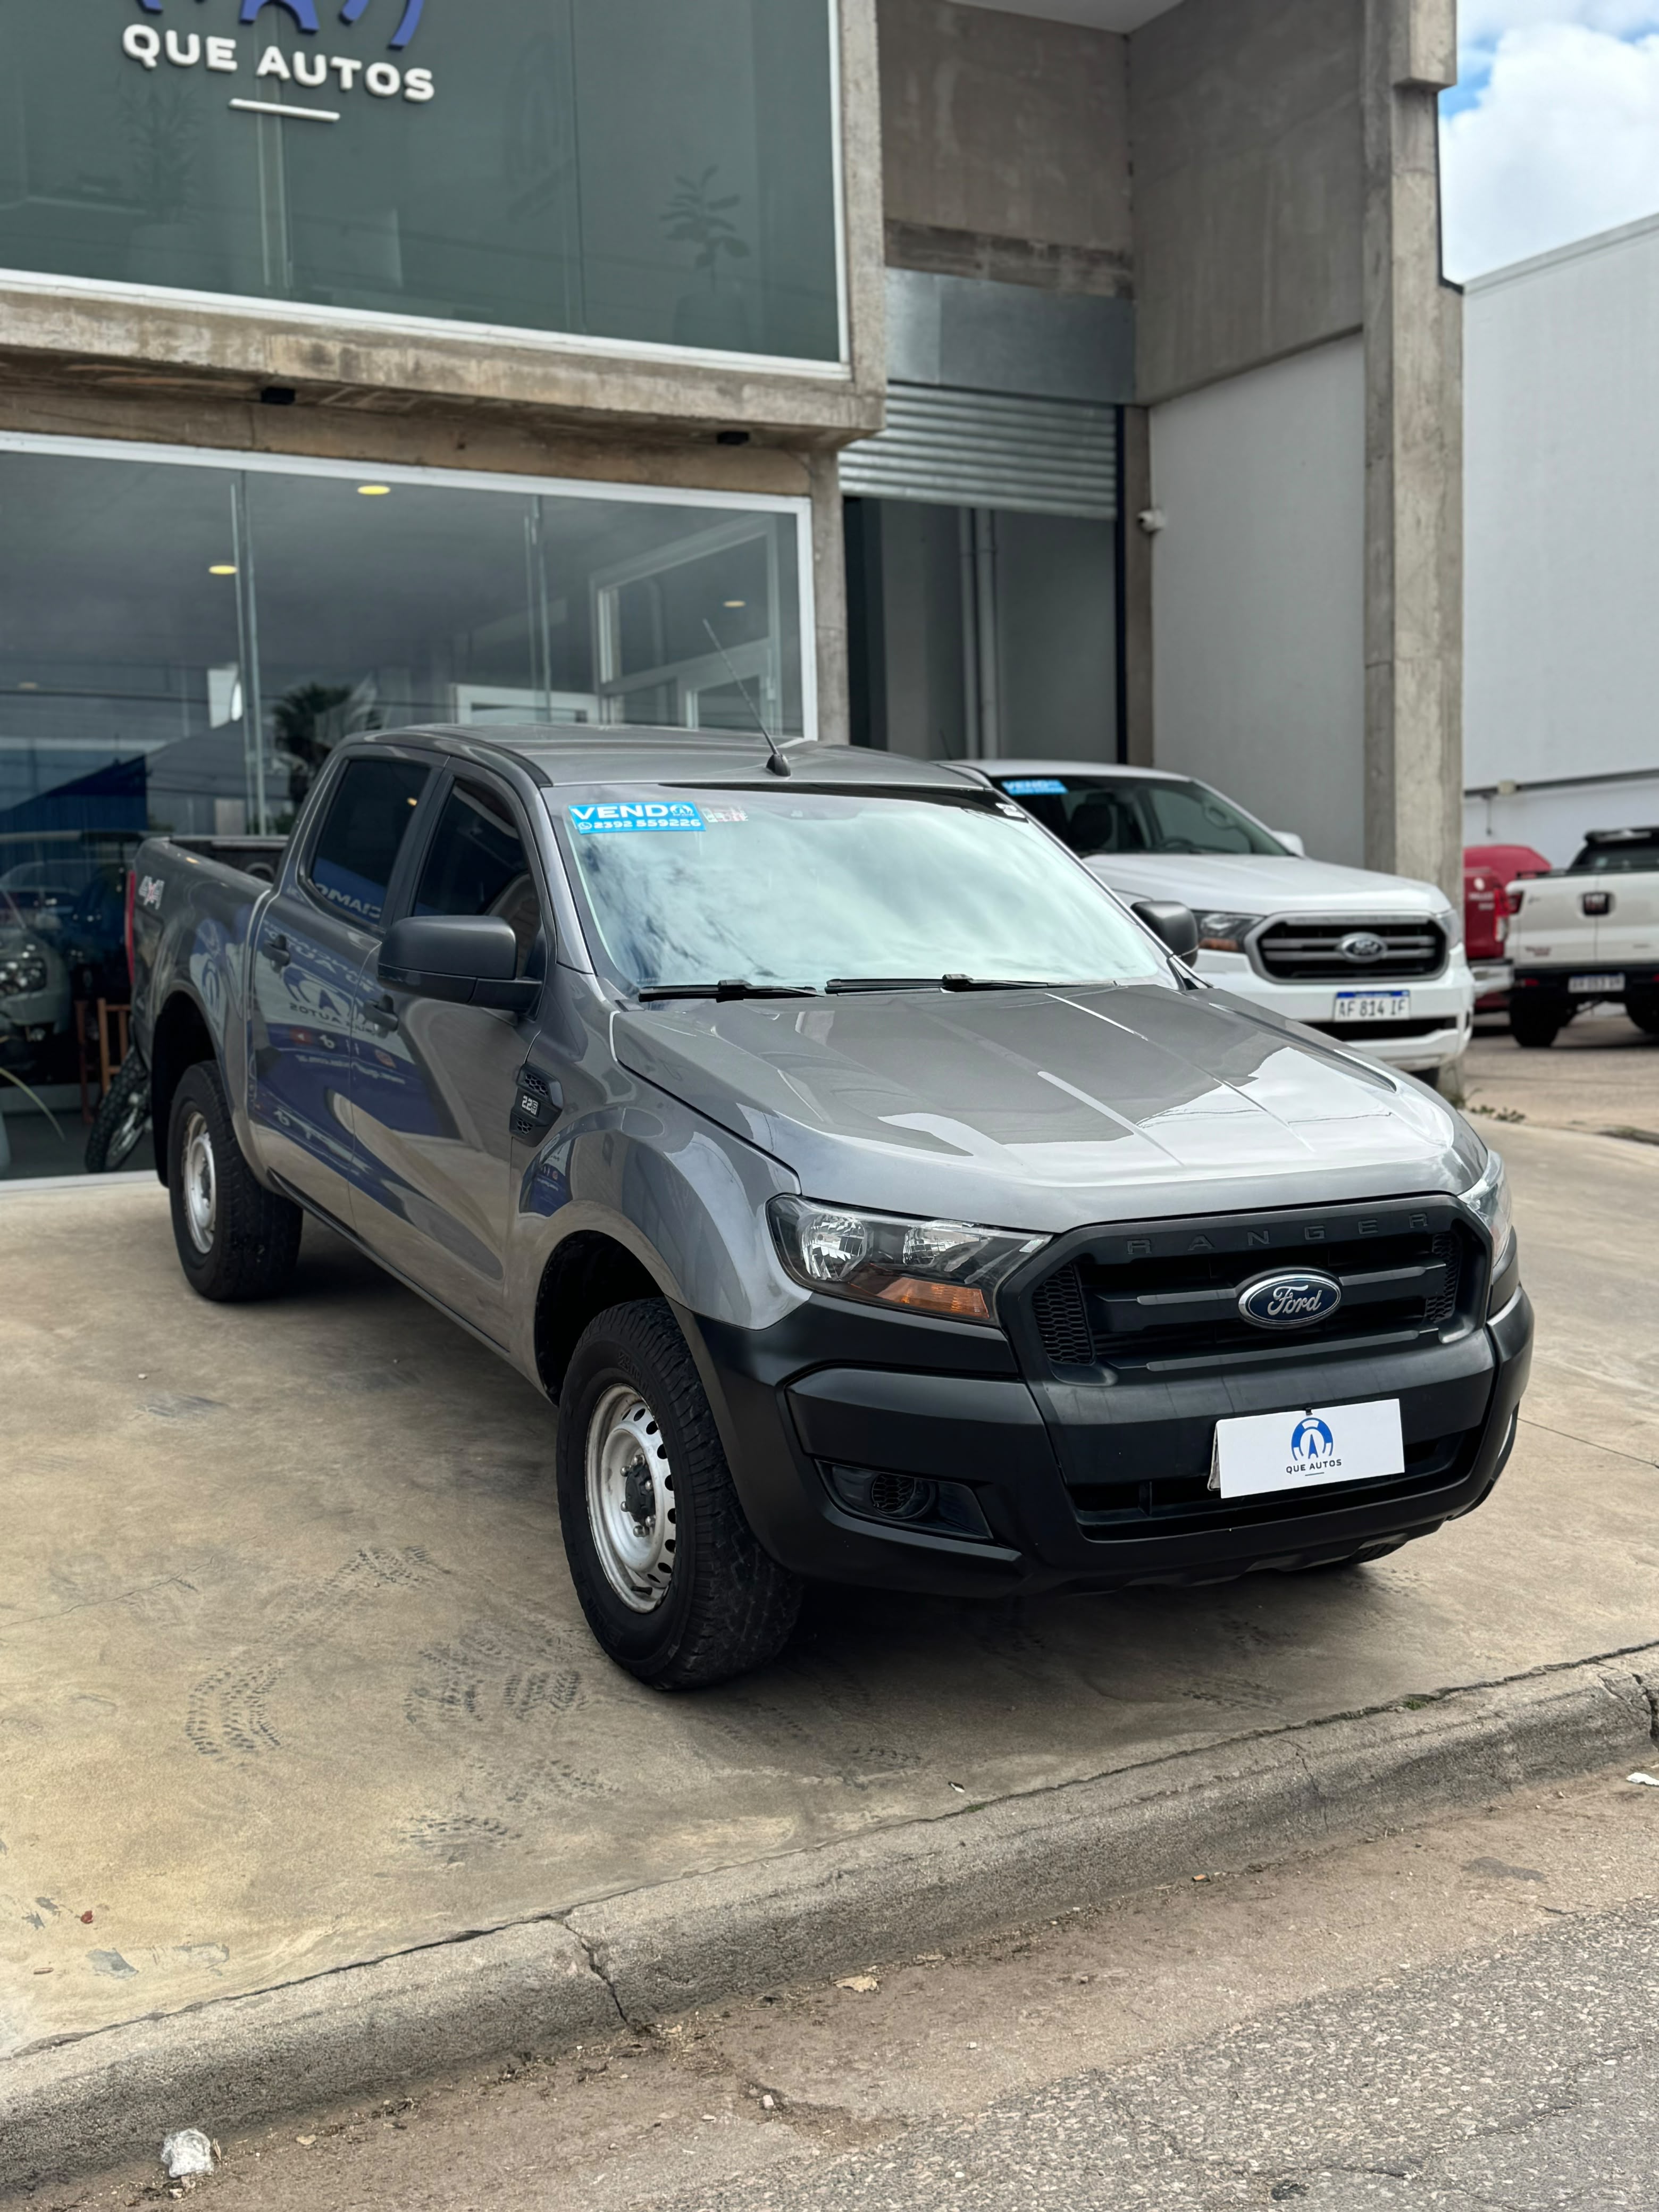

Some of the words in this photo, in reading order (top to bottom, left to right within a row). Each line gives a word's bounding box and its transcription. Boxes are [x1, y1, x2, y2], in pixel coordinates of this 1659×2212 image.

[123, 24, 238, 71] QUE
[256, 46, 435, 102] AUTOS
[636, 819, 701, 827] 559226
[1127, 1213, 1429, 1255] RANGER
[1267, 1285, 1322, 1316] Ford
[1286, 1464, 1306, 1474] QUE
[1309, 1459, 1342, 1471] AUTOS
